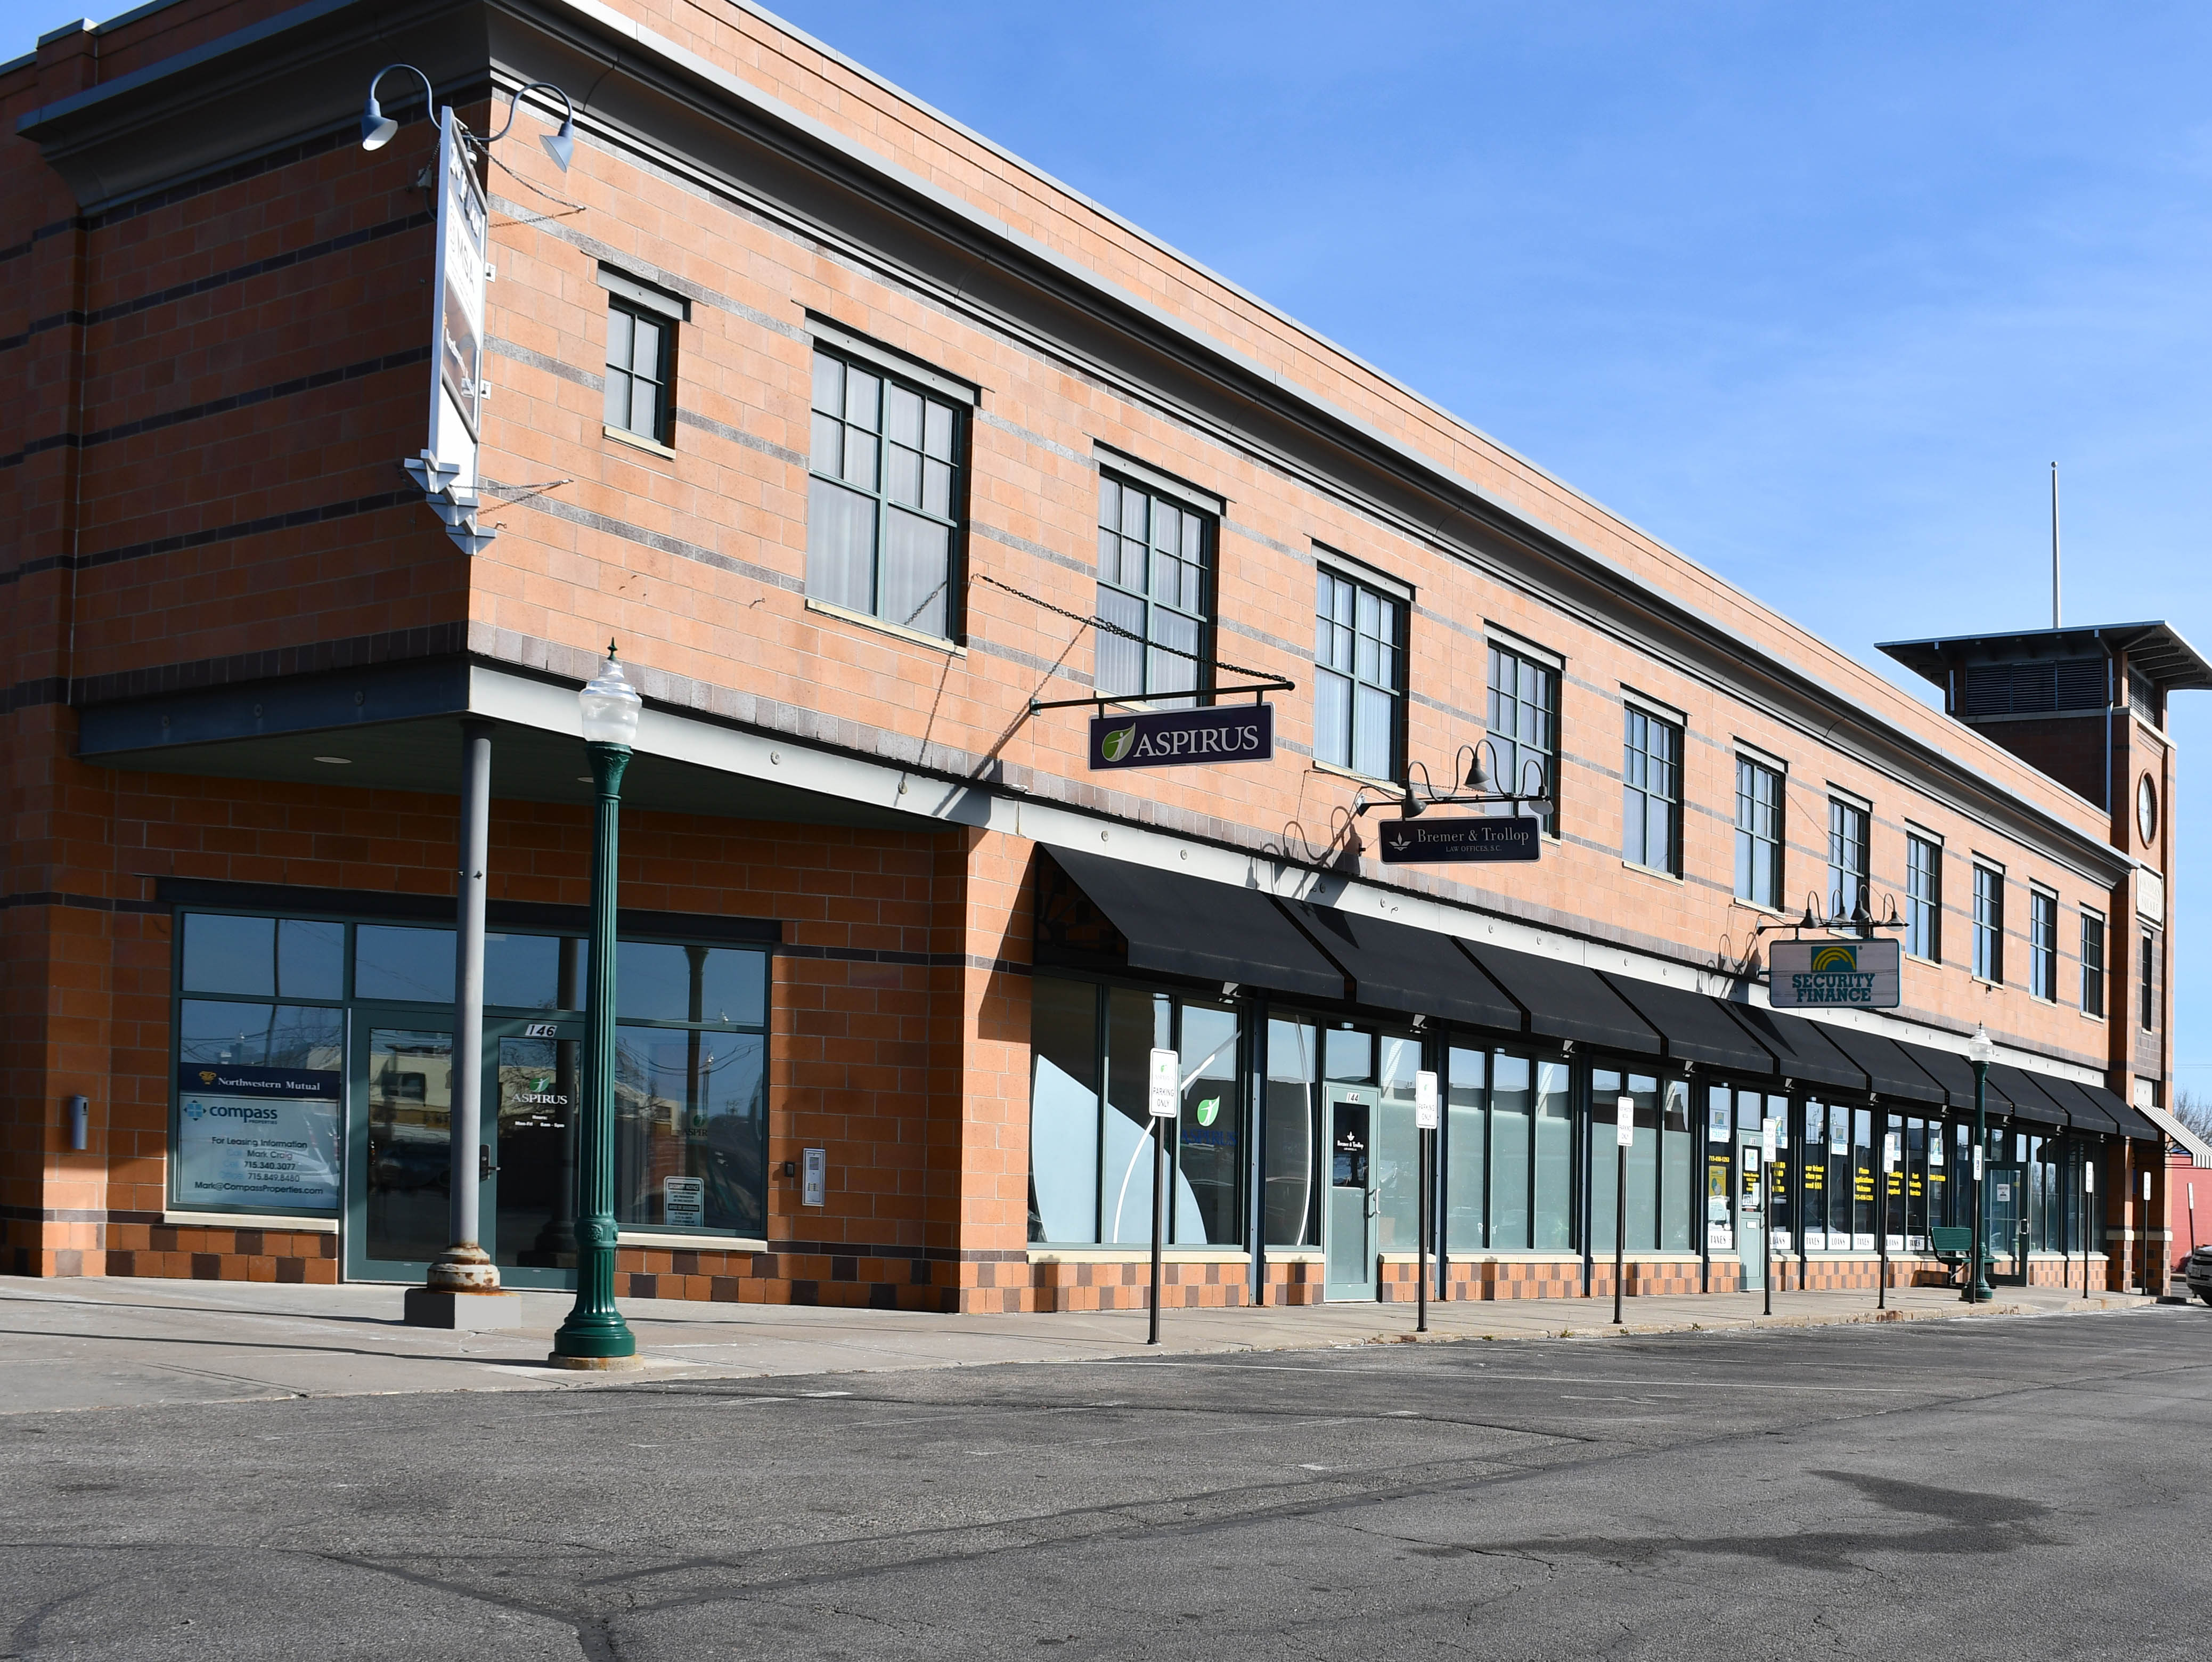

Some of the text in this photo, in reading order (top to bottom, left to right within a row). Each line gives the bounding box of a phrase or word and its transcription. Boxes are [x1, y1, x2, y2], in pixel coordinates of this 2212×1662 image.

[1133, 725, 1259, 757] ASPIRUS
[1417, 827, 1529, 845] Bremer & Trollop
[1792, 974, 1875, 988] SECURITY
[1797, 988, 1871, 1002] FINANCE
[529, 1025, 555, 1036] 146
[218, 1078, 320, 1090] Northwestern Mutual
[1153, 1087, 1174, 1096] PARKING
[511, 1093, 568, 1105] ASPIRUS
[1157, 1099, 1169, 1107] ONLY
[209, 1105, 277, 1122] compass
[227, 1137, 258, 1147] Leasing
[261, 1139, 307, 1148] Information
[1180, 1128, 1236, 1146] ASPIRUS
[271, 1151, 292, 1160] Craig
[244, 1161, 296, 1170] 715.340.3077
[194, 1182, 323, 1195] Mark@CompassProperties.com
[1710, 1235, 1726, 1244] TAXES
[1770, 1236, 1785, 1245] LOANS
